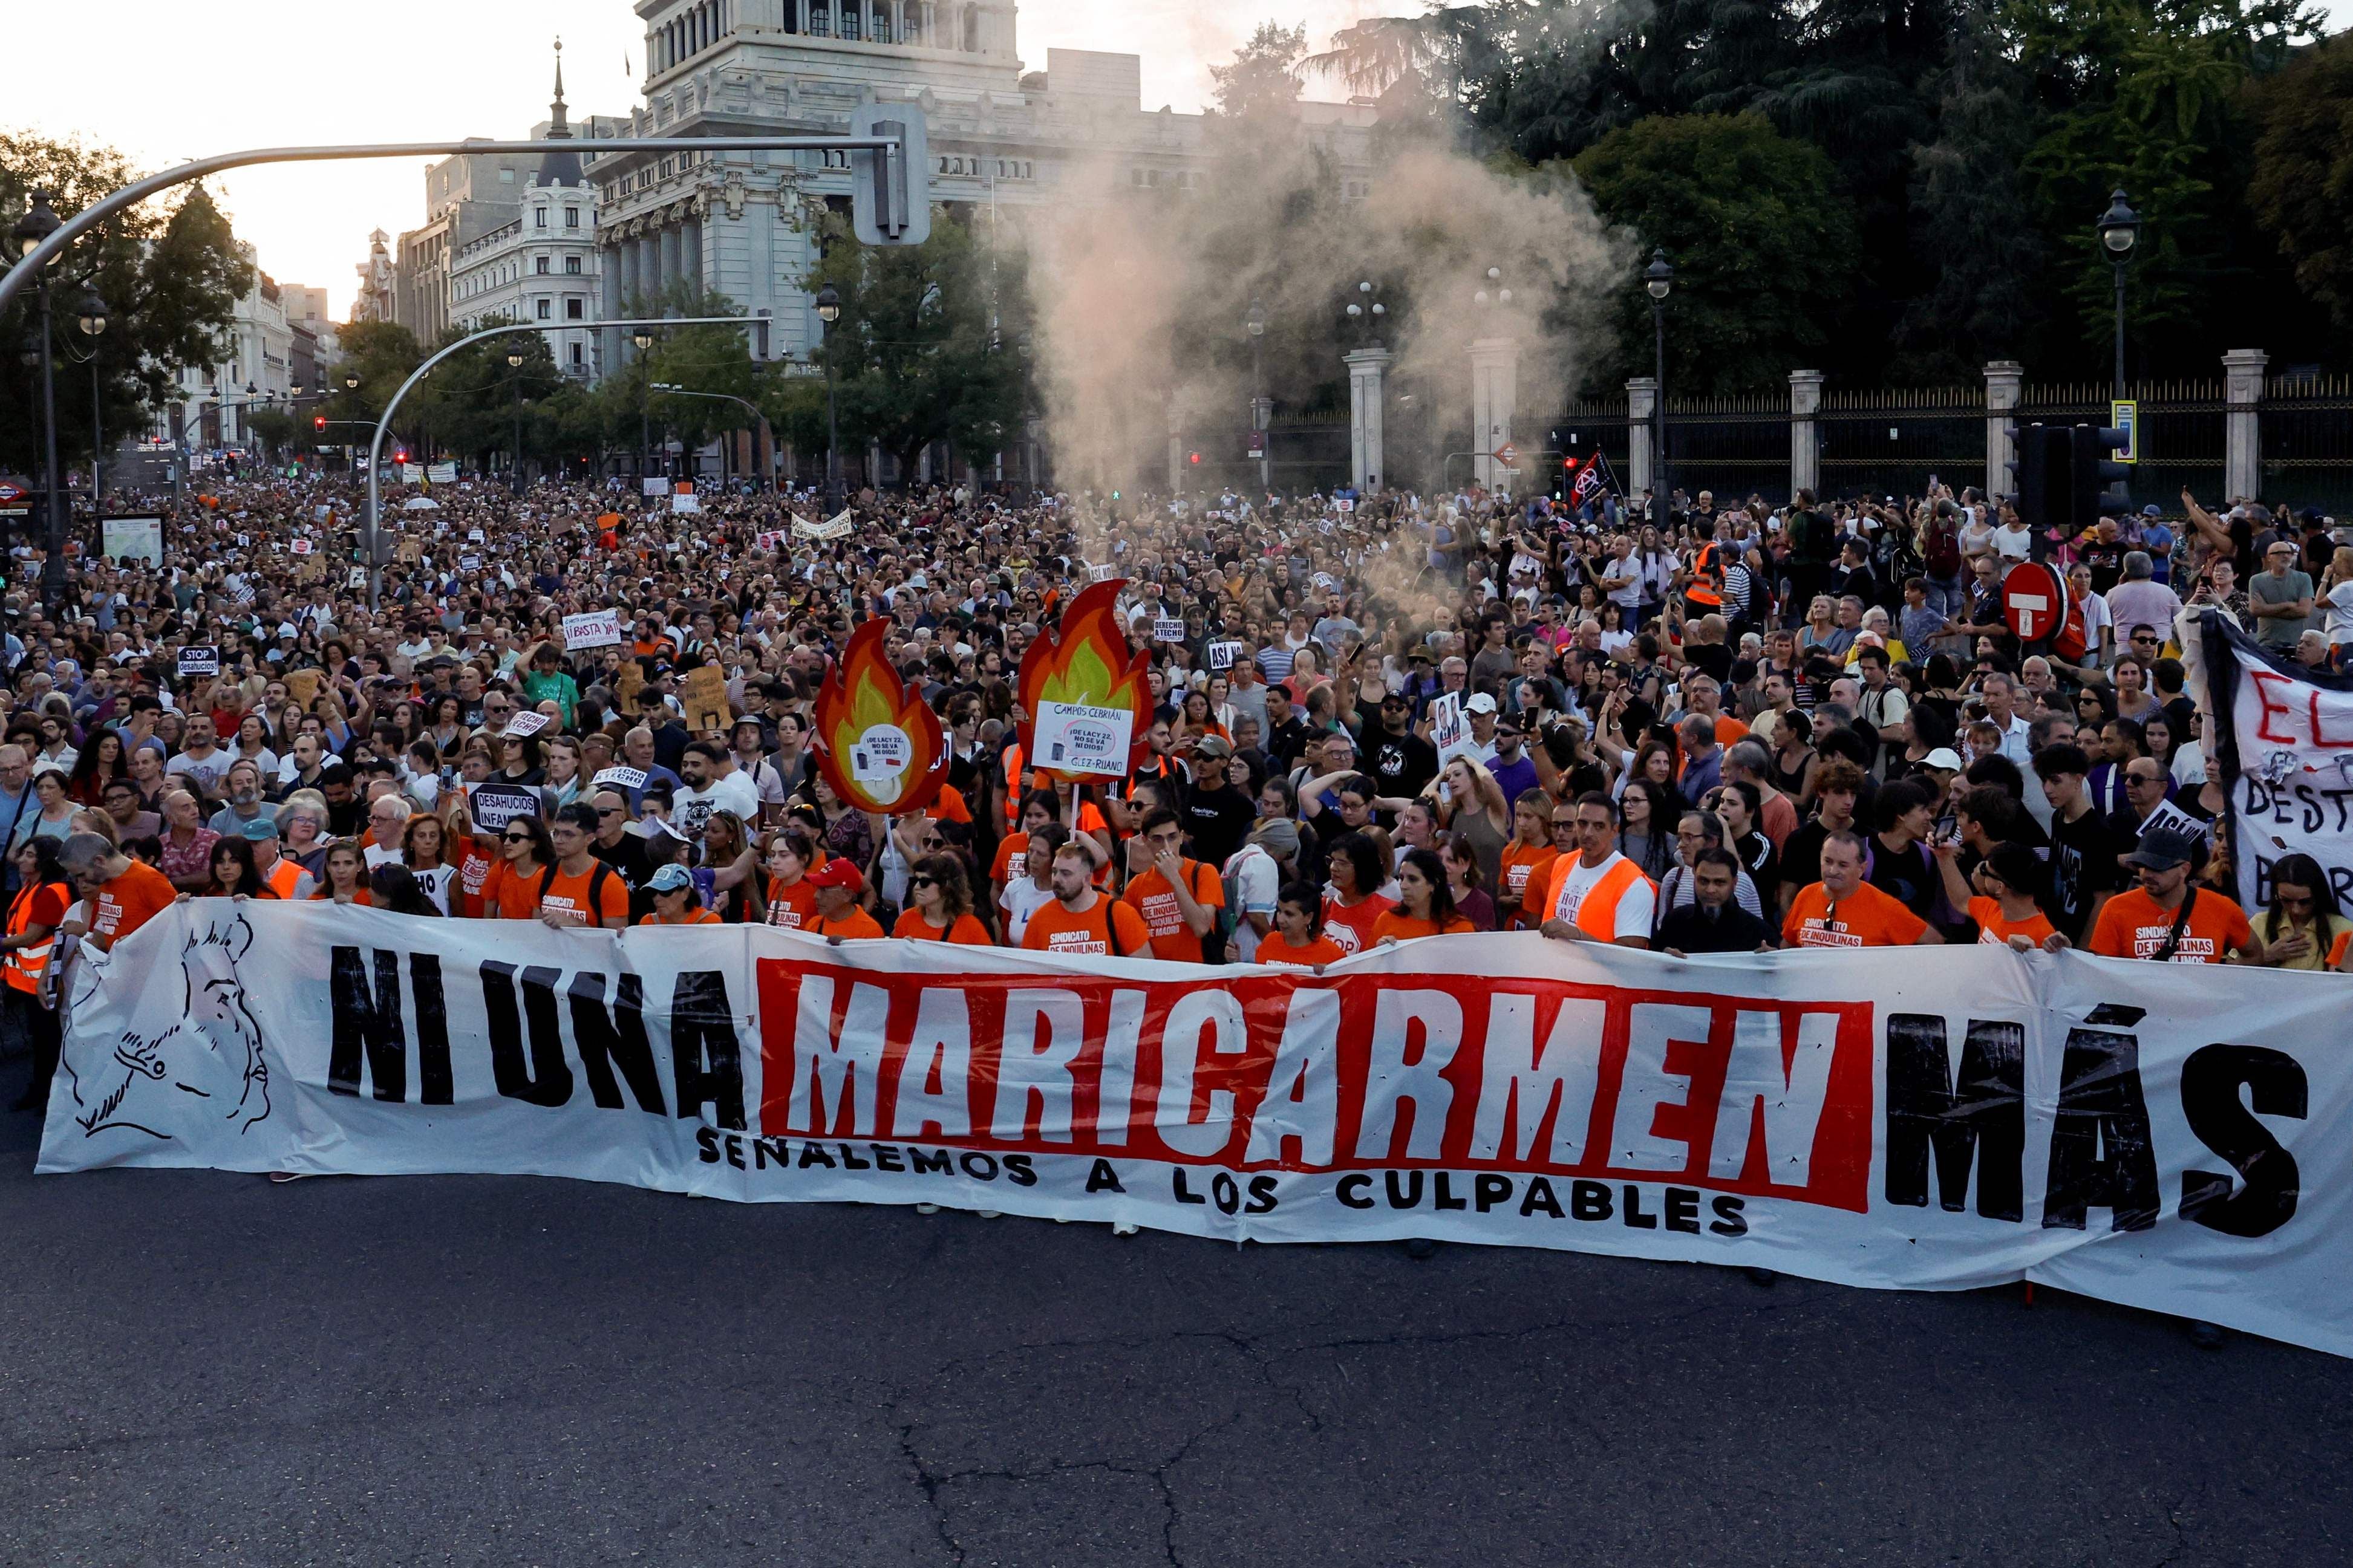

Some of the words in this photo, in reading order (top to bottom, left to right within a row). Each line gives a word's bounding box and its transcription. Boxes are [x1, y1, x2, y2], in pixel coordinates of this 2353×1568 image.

[566, 623, 601, 639] ¡¡BASTA
[602, 622, 620, 636] YA!!
[186, 650, 209, 660] STOP
[1054, 704, 1087, 715] CAMPOS
[1089, 708, 1121, 721] CEBRIÁN
[1071, 757, 1123, 772] GLEZ-RUANO
[478, 794, 534, 811] DESAHUCIOS
[542, 895, 575, 908] SINDICATO
[1142, 892, 1175, 906] SINDICAT
[1049, 930, 1090, 944] SINDICATO
[1810, 931, 1860, 948] INQUILINAS
[2136, 942, 2150, 954] DE
[327, 945, 454, 1105] NI
[479, 960, 748, 1131] UNA
[786, 974, 1840, 1188] MARICARMEN
[1884, 1002, 2309, 1238] MÁS
[696, 1126, 1038, 1186] SEÑALEMOS
[1085, 1158, 1126, 1193] A
[1173, 1166, 1279, 1215] LOS
[1336, 1168, 1749, 1238] CULPABLES
